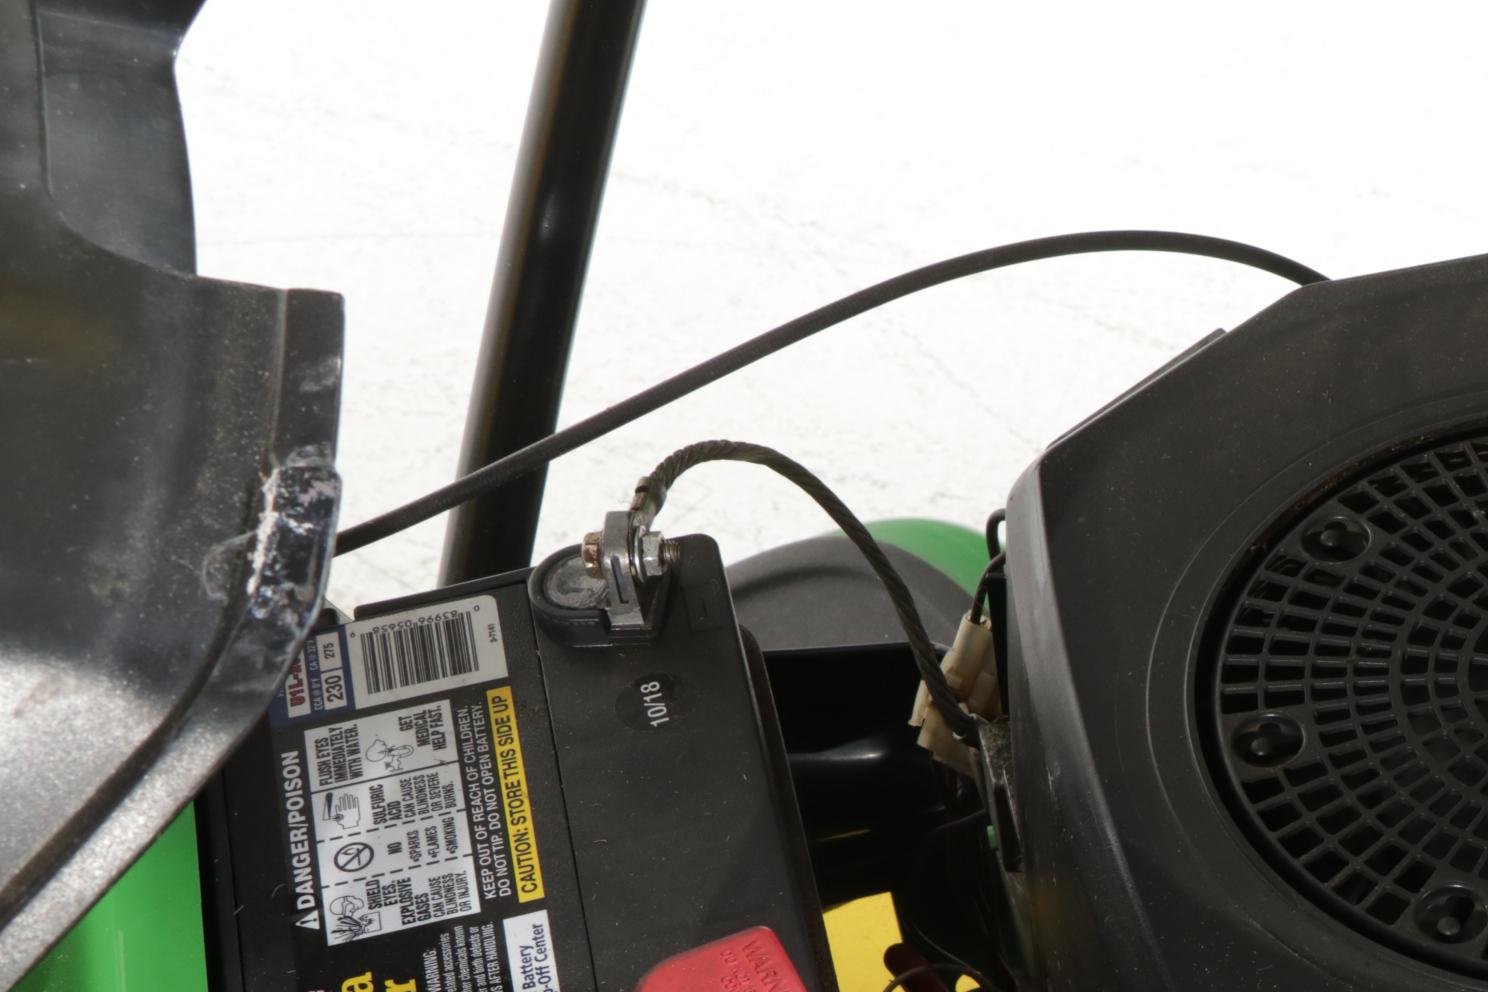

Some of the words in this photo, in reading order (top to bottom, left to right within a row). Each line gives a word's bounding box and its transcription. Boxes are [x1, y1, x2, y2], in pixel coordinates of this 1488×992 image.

[323, 643, 335, 659] 275
[325, 675, 344, 702] 230
[428, 705, 444, 729] FAST.
[492, 695, 510, 715] UP
[640, 681, 669, 727] 10/18
[398, 716, 413, 731] GET
[413, 710, 430, 747] MEDICAL
[458, 706, 476, 766] CHILDREN.
[472, 702, 490, 753] BATTERY.
[495, 717, 515, 749] SIDE
[315, 737, 330, 760] EYES
[345, 724, 361, 754] WATER.
[432, 732, 447, 750] HELP
[329, 726, 348, 782] IMMEDIATELY
[348, 755, 363, 779] WITH
[500, 749, 519, 780] THIS
[318, 761, 333, 786] FLUSH
[466, 768, 480, 783] OF
[479, 753, 496, 787] OPEN
[400, 776, 414, 802] CAUSE
[413, 774, 429, 815] BLINDNESS
[427, 772, 442, 800] SEVERE
[369, 784, 387, 825] SULFURIC
[388, 801, 401, 821] ACID
[403, 803, 416, 818] CAN
[431, 802, 443, 812] OR
[469, 785, 487, 823] REACH
[483, 788, 498, 812] NOT
[505, 780, 527, 826] STORE
[281, 750, 316, 911] DANGER/POISON
[474, 824, 488, 840] OF
[488, 812, 501, 829] DO
[388, 842, 402, 855] NO
[477, 841, 492, 865] OUT
[491, 831, 504, 856] TIP.
[494, 857, 509, 879] NOT
[514, 827, 538, 895] CAUTION:
[366, 880, 383, 910] SHIELD
[382, 880, 398, 906] EYES.
[428, 876, 443, 899] CAUSE
[442, 873, 458, 915] BLINDNESS
[455, 870, 470, 898] INJURY.
[481, 865, 497, 900] KEEP
[498, 880, 512, 897] DO
[397, 877, 416, 925] EXPLOSIVE
[415, 893, 432, 922] GASES
[431, 901, 445, 918] CAN
[459, 900, 472, 912] OR
[452, 925, 465, 947] known
[468, 933, 482, 957] defects
[533, 923, 549, 963] Center
[438, 932, 453, 971] accessories
[455, 947, 470, 980] chemicals
[471, 957, 485, 973] birth
[487, 960, 500, 984] AFTER
[520, 945, 537, 992] Battery
[474, 973, 486, 986] and
